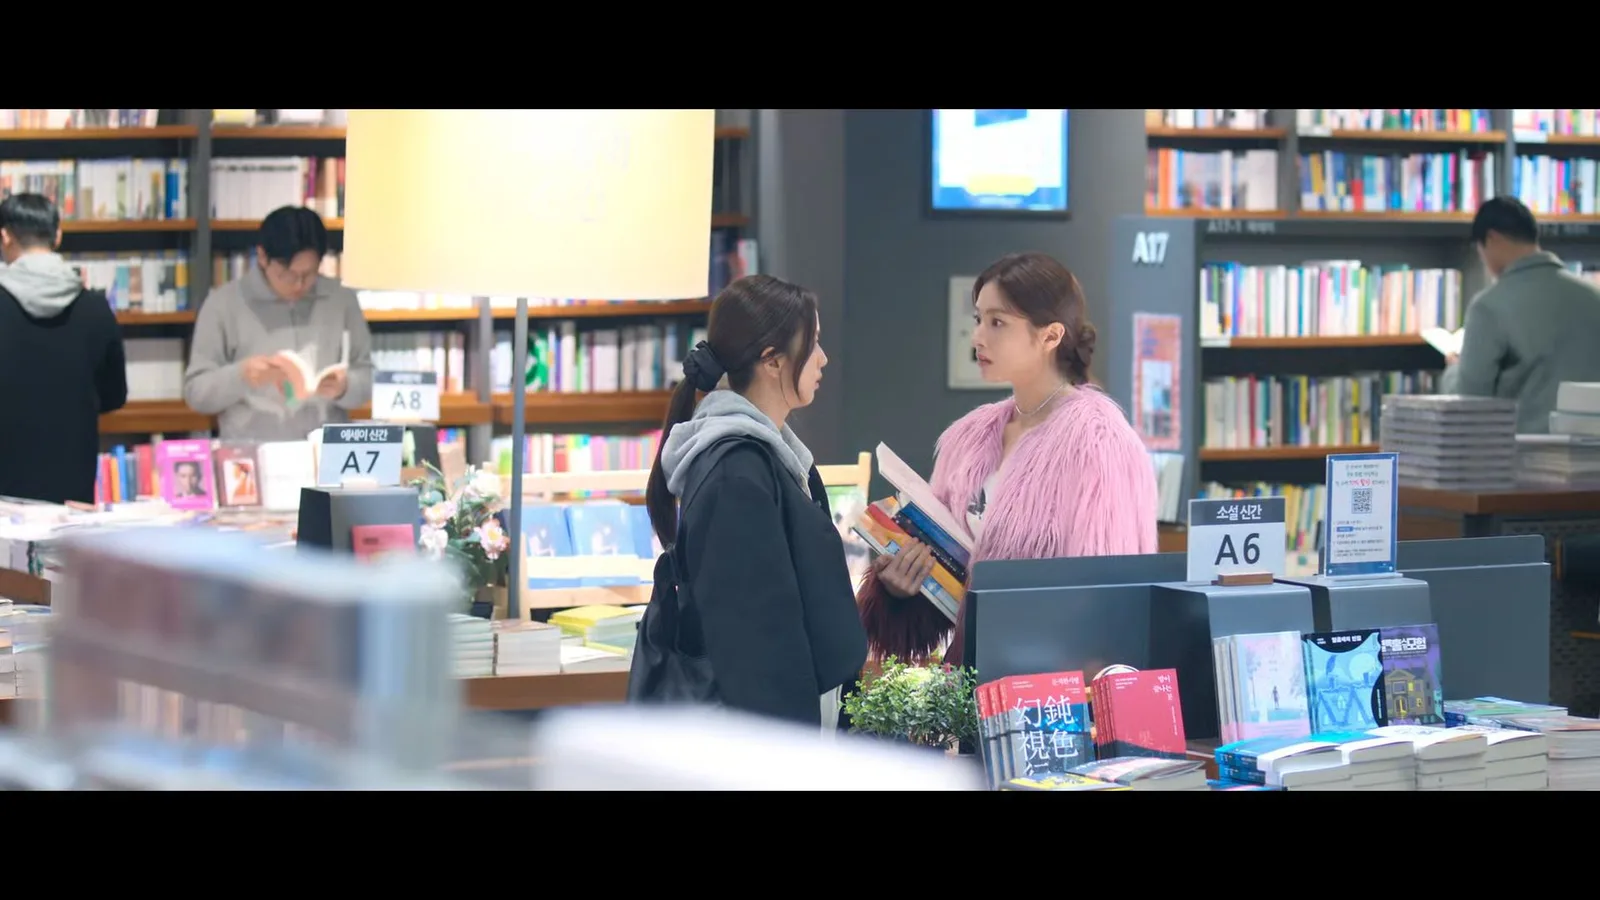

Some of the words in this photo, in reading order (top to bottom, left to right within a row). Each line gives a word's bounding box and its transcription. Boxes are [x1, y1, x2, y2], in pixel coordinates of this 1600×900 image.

[1132, 231, 1170, 264] A17
[391, 390, 422, 410] A8
[340, 429, 368, 441] 에세이
[369, 429, 388, 441] 신간
[340, 451, 380, 474] A7
[1216, 505, 1238, 521] 소설
[1240, 504, 1262, 520] 신간
[1214, 533, 1260, 565] A6
